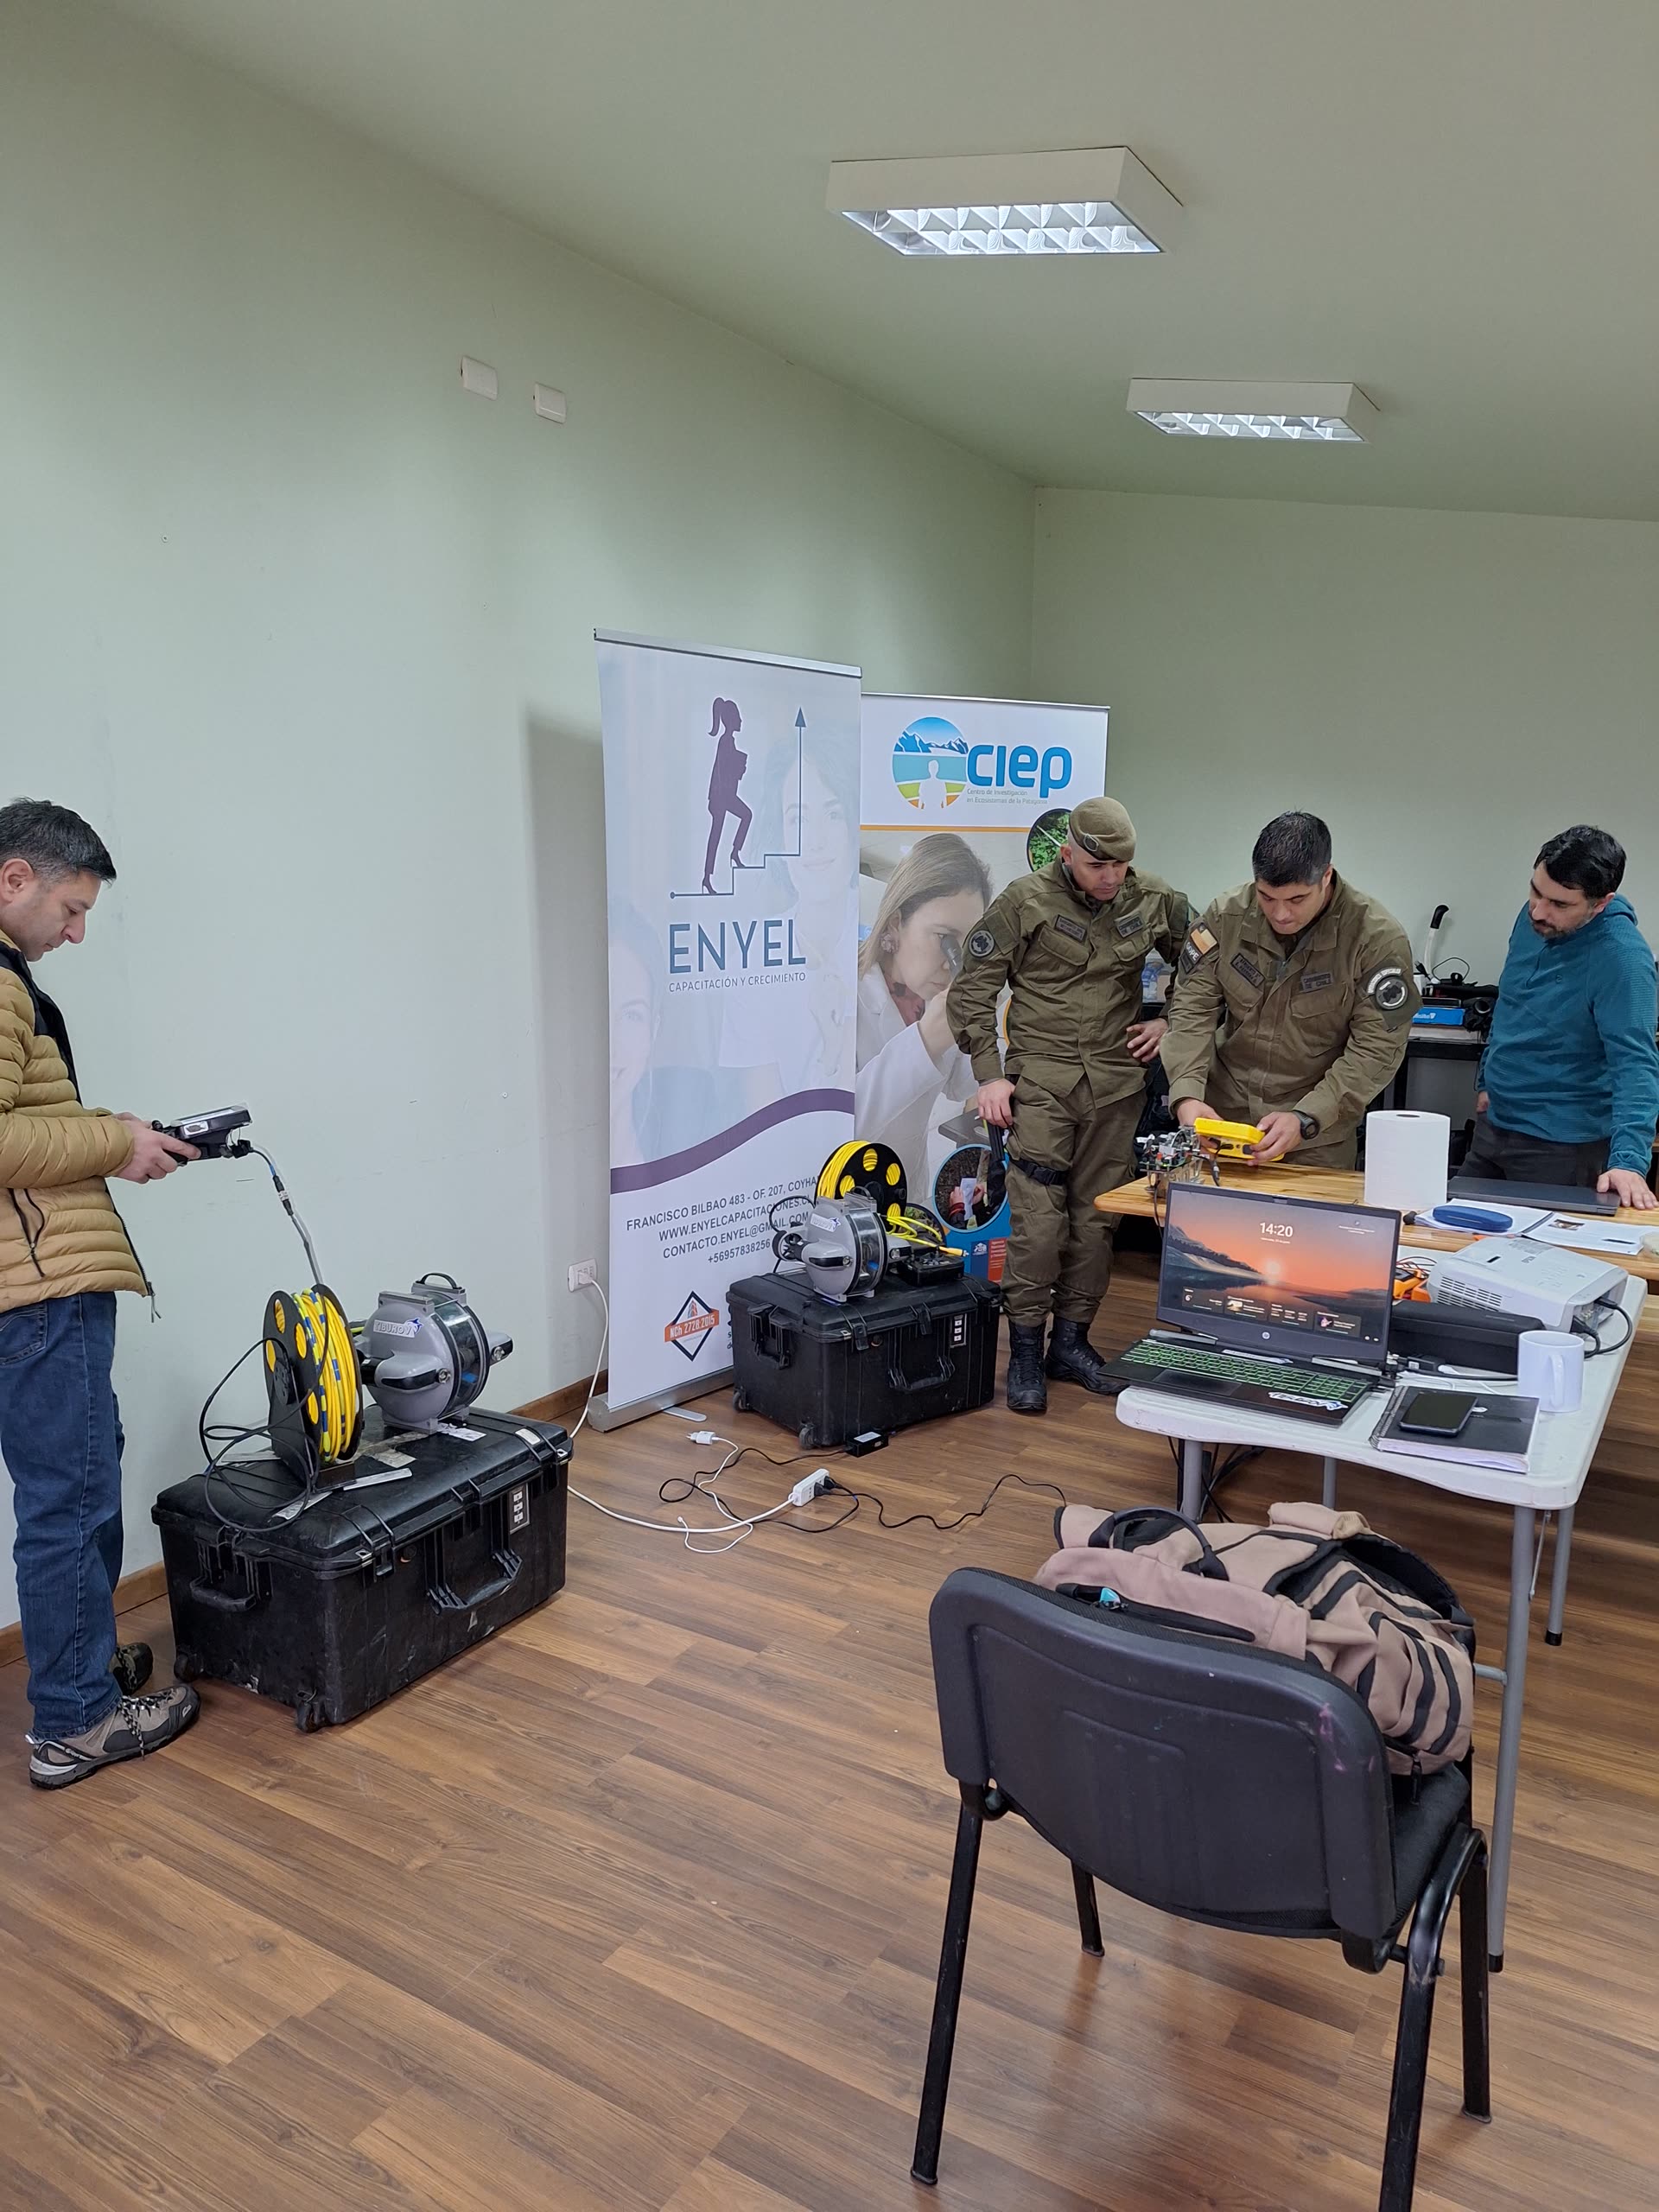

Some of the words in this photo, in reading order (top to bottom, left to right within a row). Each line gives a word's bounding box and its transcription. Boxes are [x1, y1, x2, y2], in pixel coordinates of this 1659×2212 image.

[669, 918, 807, 975] ENYEL
[669, 976, 738, 993] CAPACITACIÓN
[740, 977, 747, 986] Y
[747, 971, 806, 986] CRECIMIENTO
[626, 1210, 690, 1230] FRANCISCO
[690, 1198, 728, 1216] BILBAO
[728, 1193, 746, 1205] 483
[753, 1189, 766, 1199] OF.
[768, 1184, 786, 1197] 207,
[787, 1176, 817, 1192] COYHA
[1259, 1222, 1294, 1237] 14:20
[708, 1238, 772, 1264] +56957838256
[670, 1326, 683, 1338] NCh
